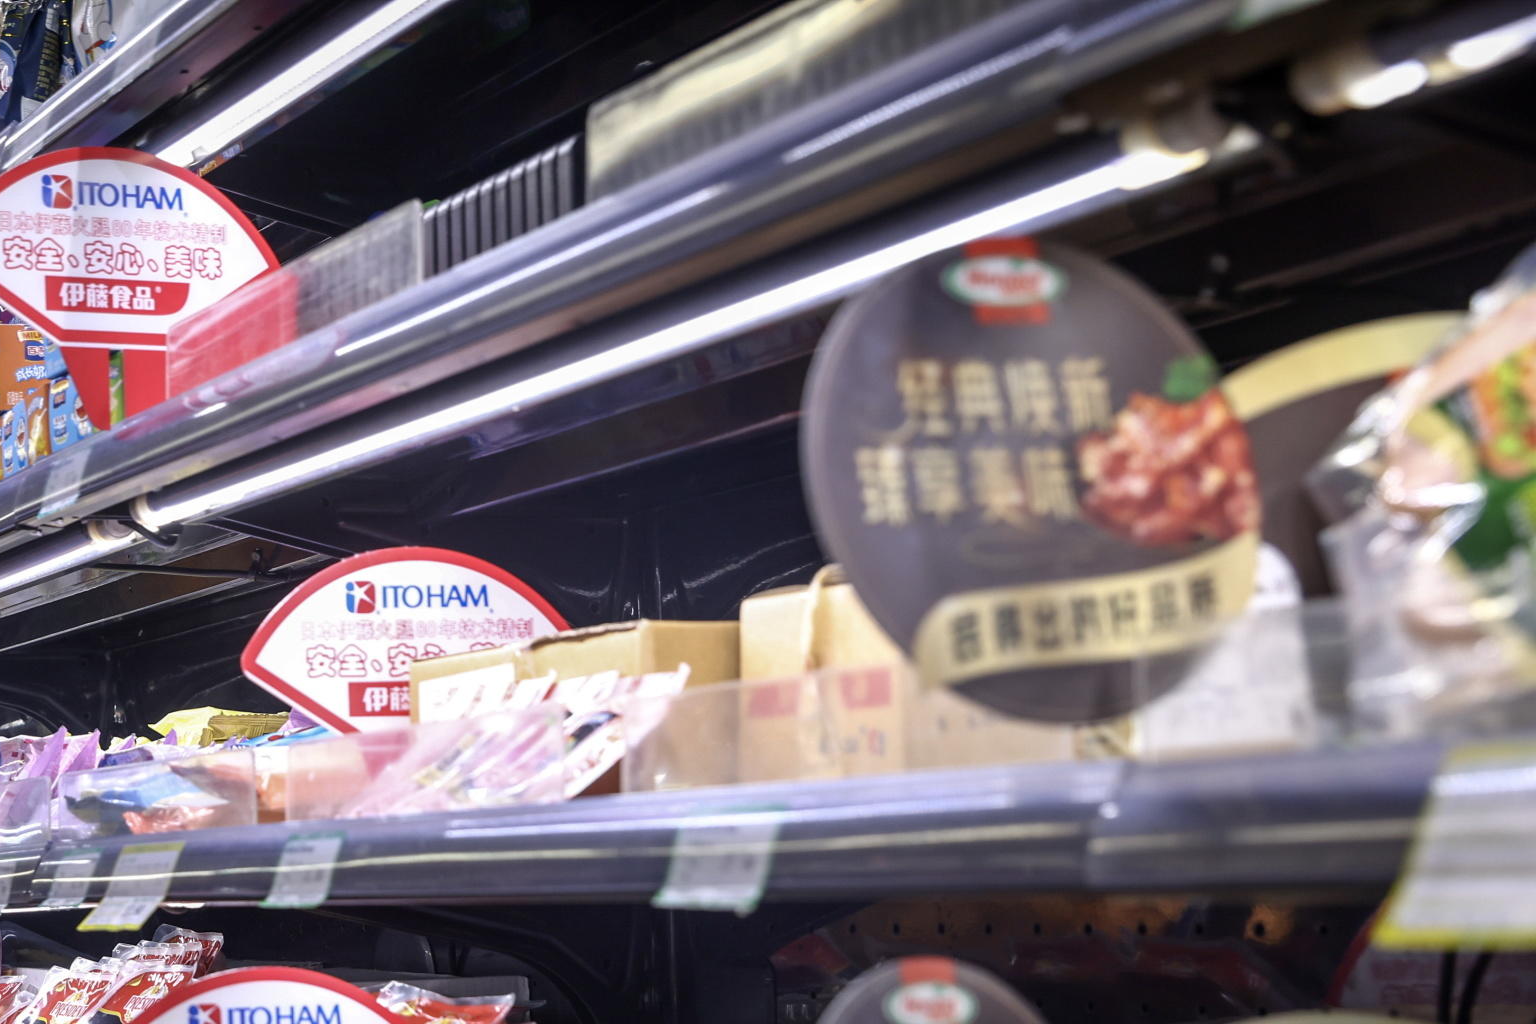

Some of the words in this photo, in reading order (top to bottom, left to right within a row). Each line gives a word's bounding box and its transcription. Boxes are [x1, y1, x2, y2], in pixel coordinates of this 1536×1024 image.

[77, 181, 184, 211] ITOHAM
[3, 236, 223, 280] 安全、安心、美味
[59, 281, 157, 311] 伊藤食品
[382, 584, 489, 608] ITOHAM
